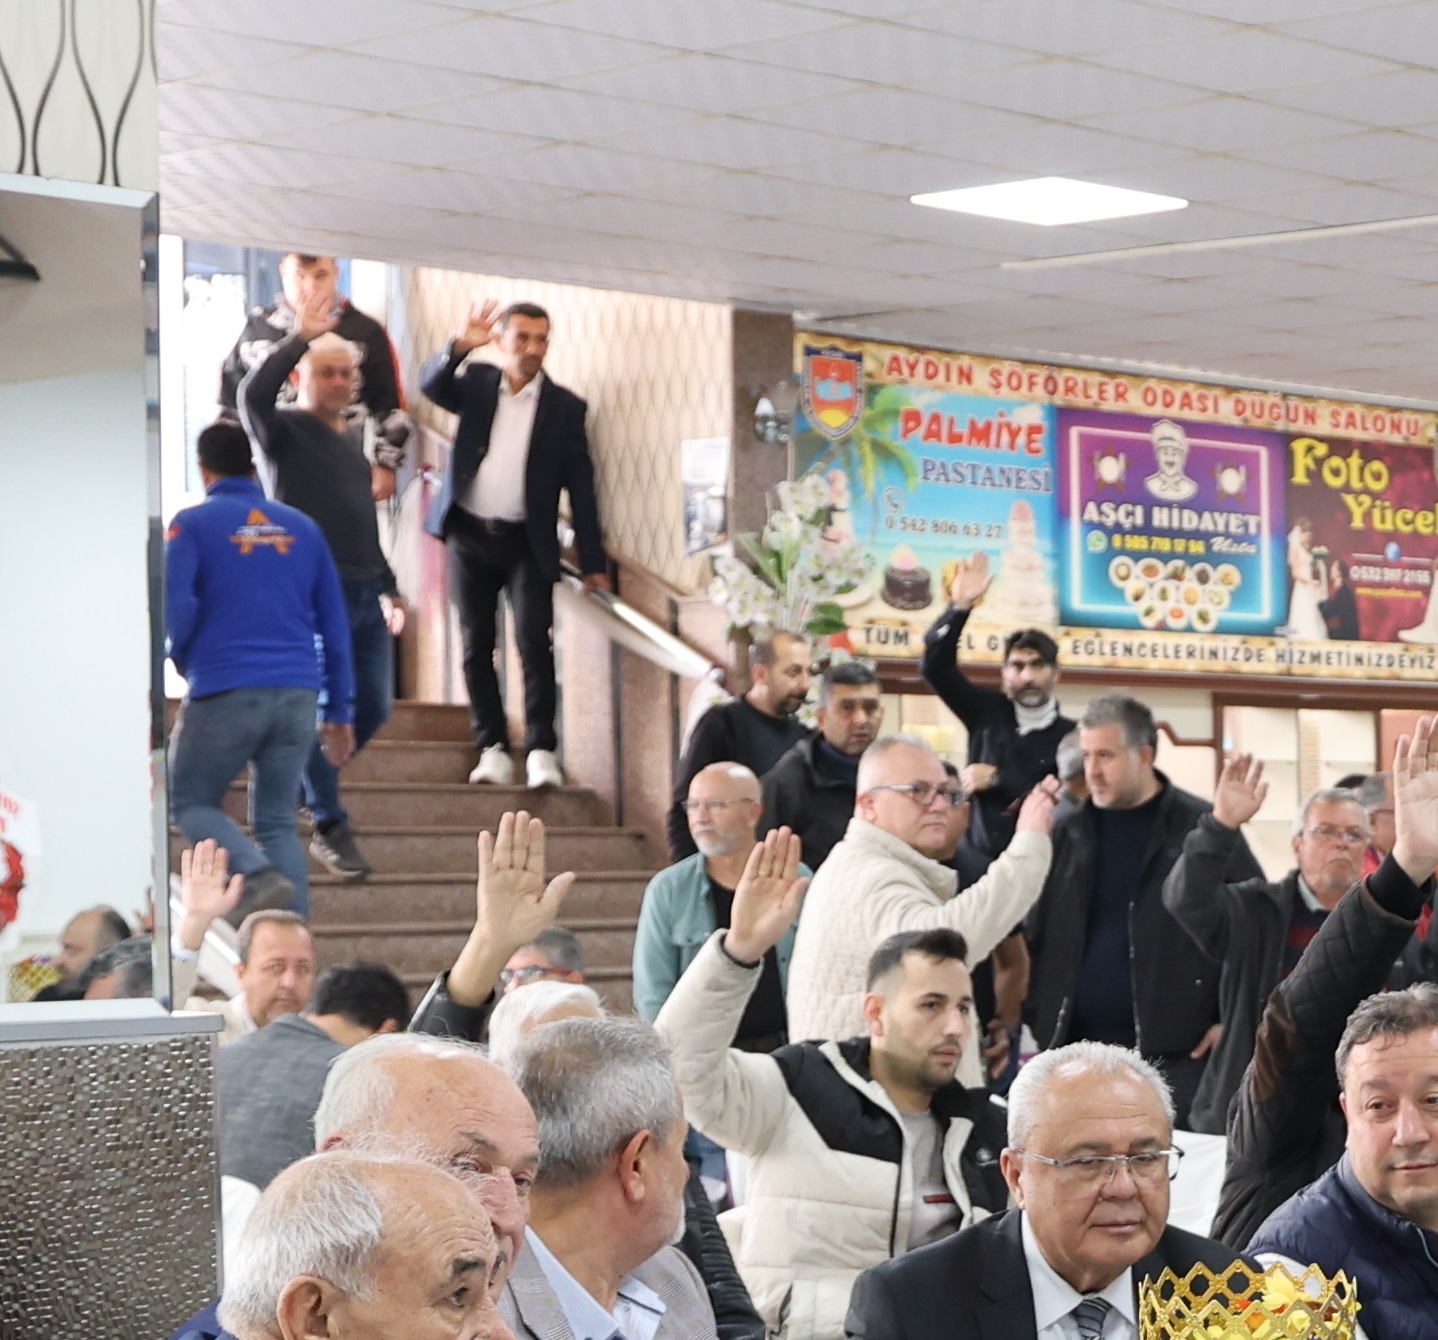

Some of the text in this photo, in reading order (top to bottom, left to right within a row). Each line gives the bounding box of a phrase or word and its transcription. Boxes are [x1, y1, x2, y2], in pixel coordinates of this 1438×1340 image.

[886, 353, 974, 387] AYDIN
[1142, 385, 1220, 415] ODASI
[1330, 408, 1421, 437] SALONU
[900, 406, 1047, 456] PALMİYE
[921, 456, 1053, 493] PASTANESİ
[1289, 437, 1390, 492] Foto
[1082, 500, 1261, 535] AŞÇI HİDAYET
[862, 623, 910, 646] TÜM
